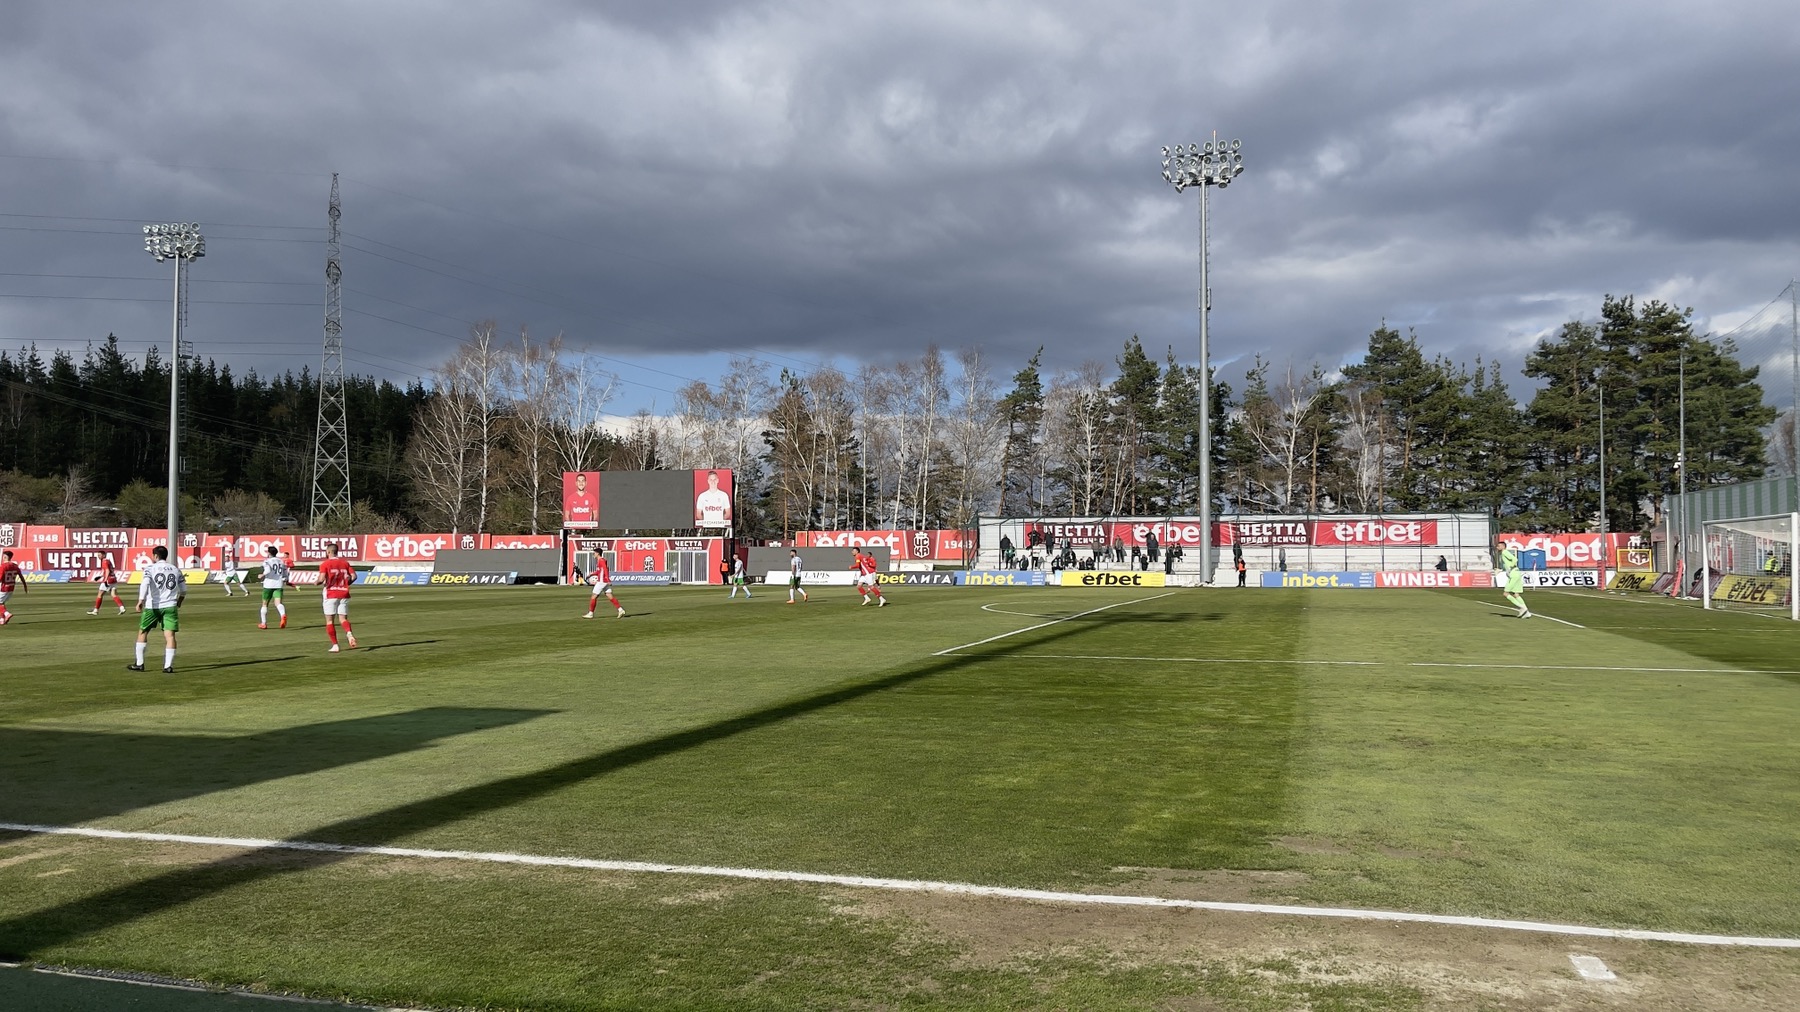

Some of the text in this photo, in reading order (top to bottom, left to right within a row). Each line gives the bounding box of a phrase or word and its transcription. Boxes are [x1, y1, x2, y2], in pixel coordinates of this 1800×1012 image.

[1240, 523, 1306, 536] ЧЕСТТА
[1333, 522, 1421, 542] efbet
[33, 534, 58, 542] 1948
[72, 532, 128, 544] ЧЕСТТА
[143, 538, 166, 546] 1948
[375, 536, 446, 558] efbet
[624, 540, 657, 550] efbet
[154, 573, 176, 590] 98
[431, 573, 470, 584] efbet
[470, 576, 506, 584] ЛИГА
[908, 574, 952, 584] ЛИГА
[1081, 573, 1142, 586] efbet
[1382, 572, 1462, 586] WINBET
[1540, 576, 1595, 586] РУСЕВ
